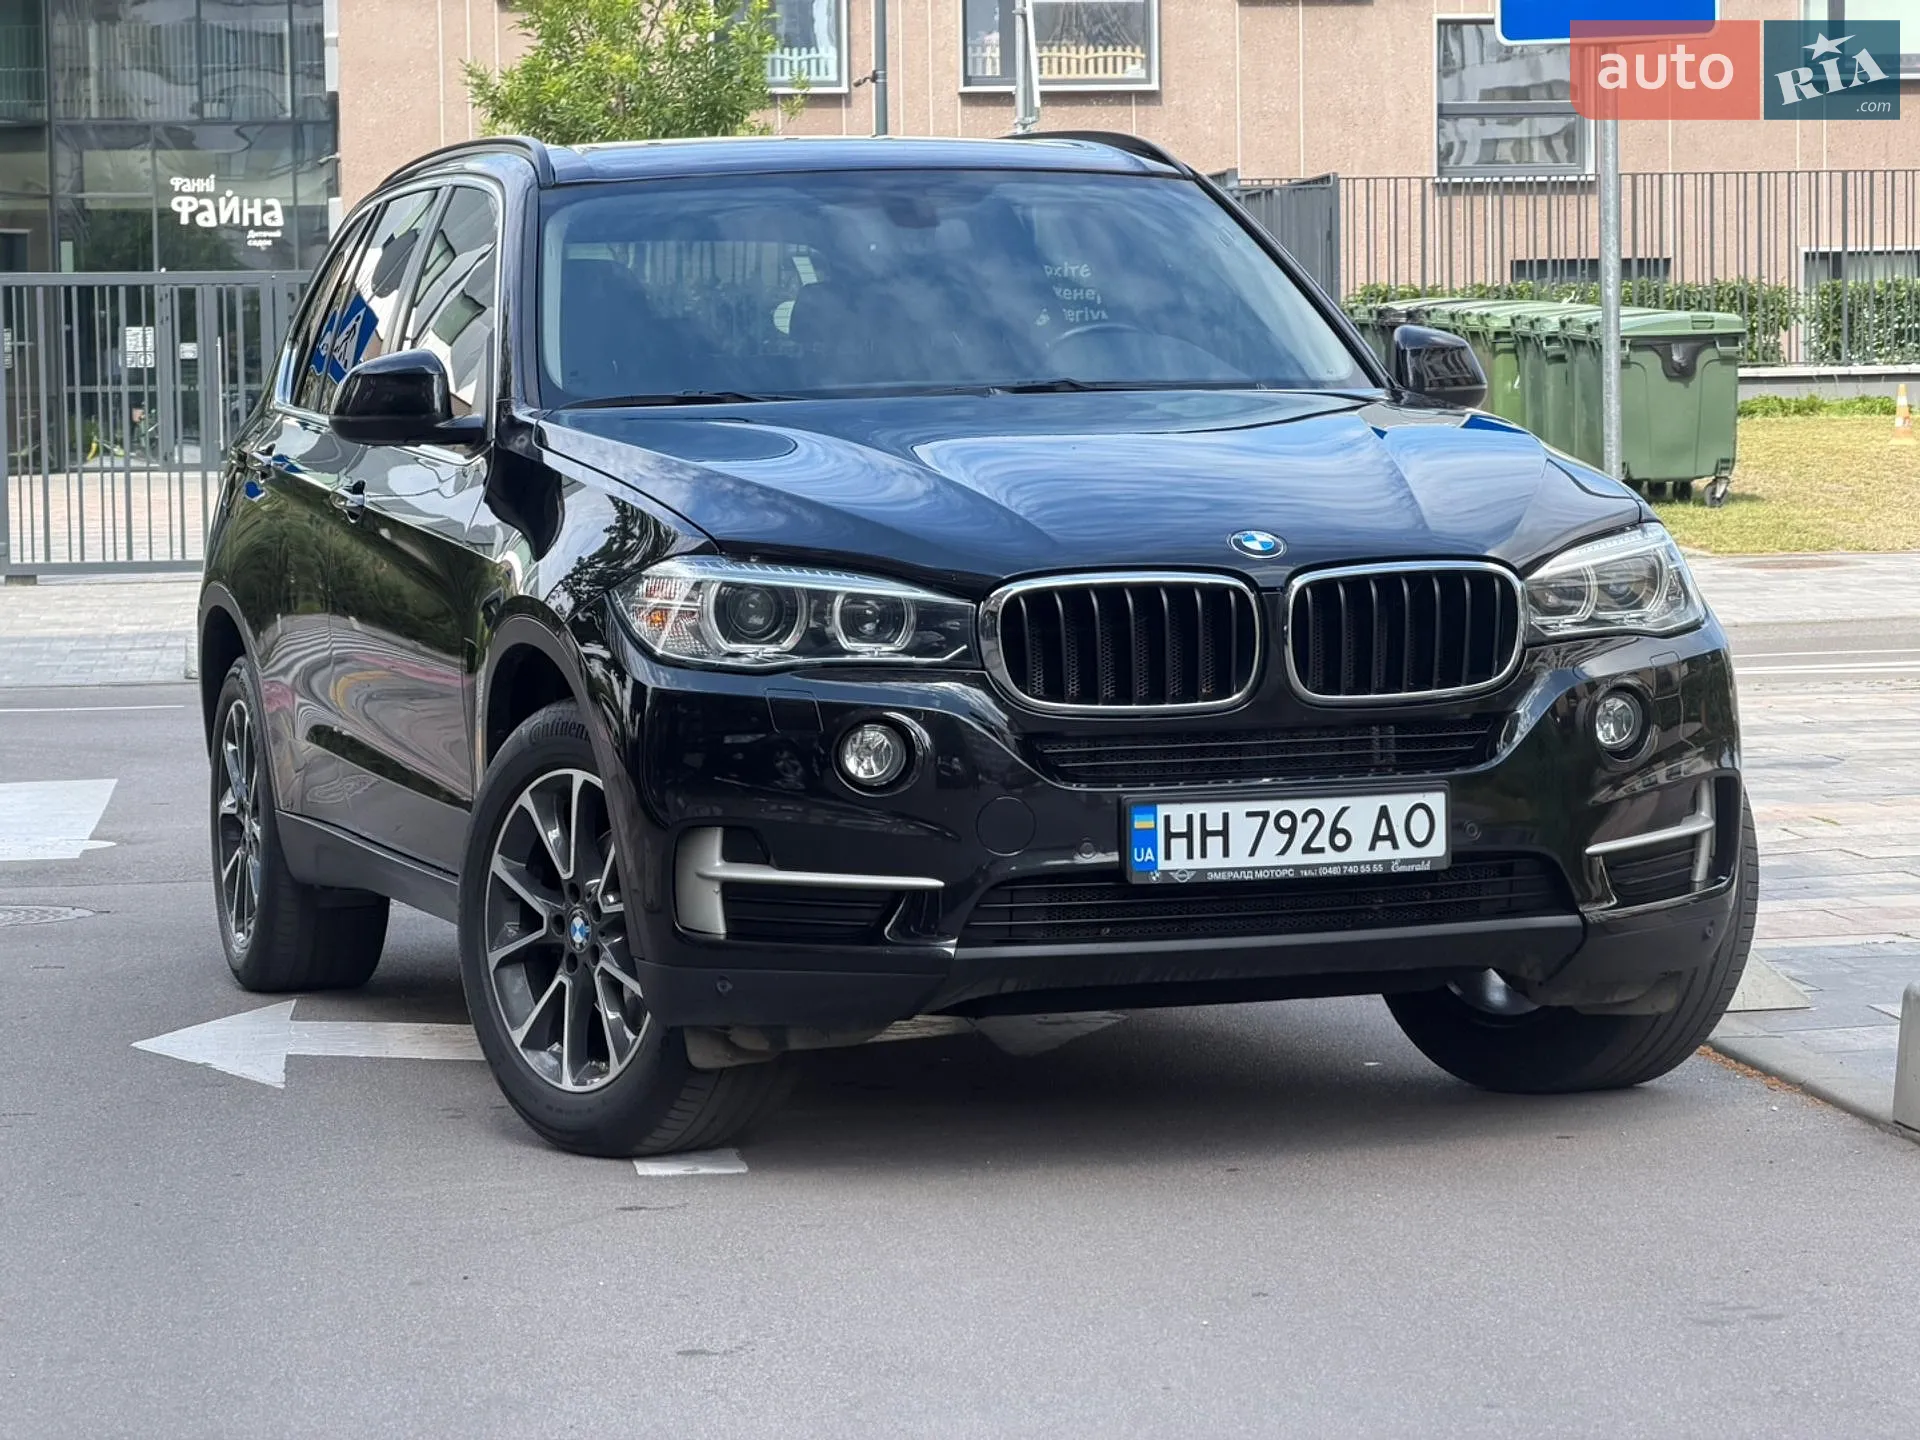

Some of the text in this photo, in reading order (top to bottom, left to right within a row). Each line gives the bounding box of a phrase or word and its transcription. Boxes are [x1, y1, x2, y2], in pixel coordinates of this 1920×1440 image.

[169, 174, 216, 193] Фанні
[170, 189, 285, 228] Файна
[1164, 802, 1436, 860] HH 7926 AO
[1134, 848, 1155, 862] UA
[1206, 870, 1254, 880] ЭМЕРАЛД
[1255, 868, 1295, 879] МОТОРС
[1343, 865, 1359, 874] 740
[1360, 864, 1371, 873] 55
[1372, 863, 1384, 872] 55
